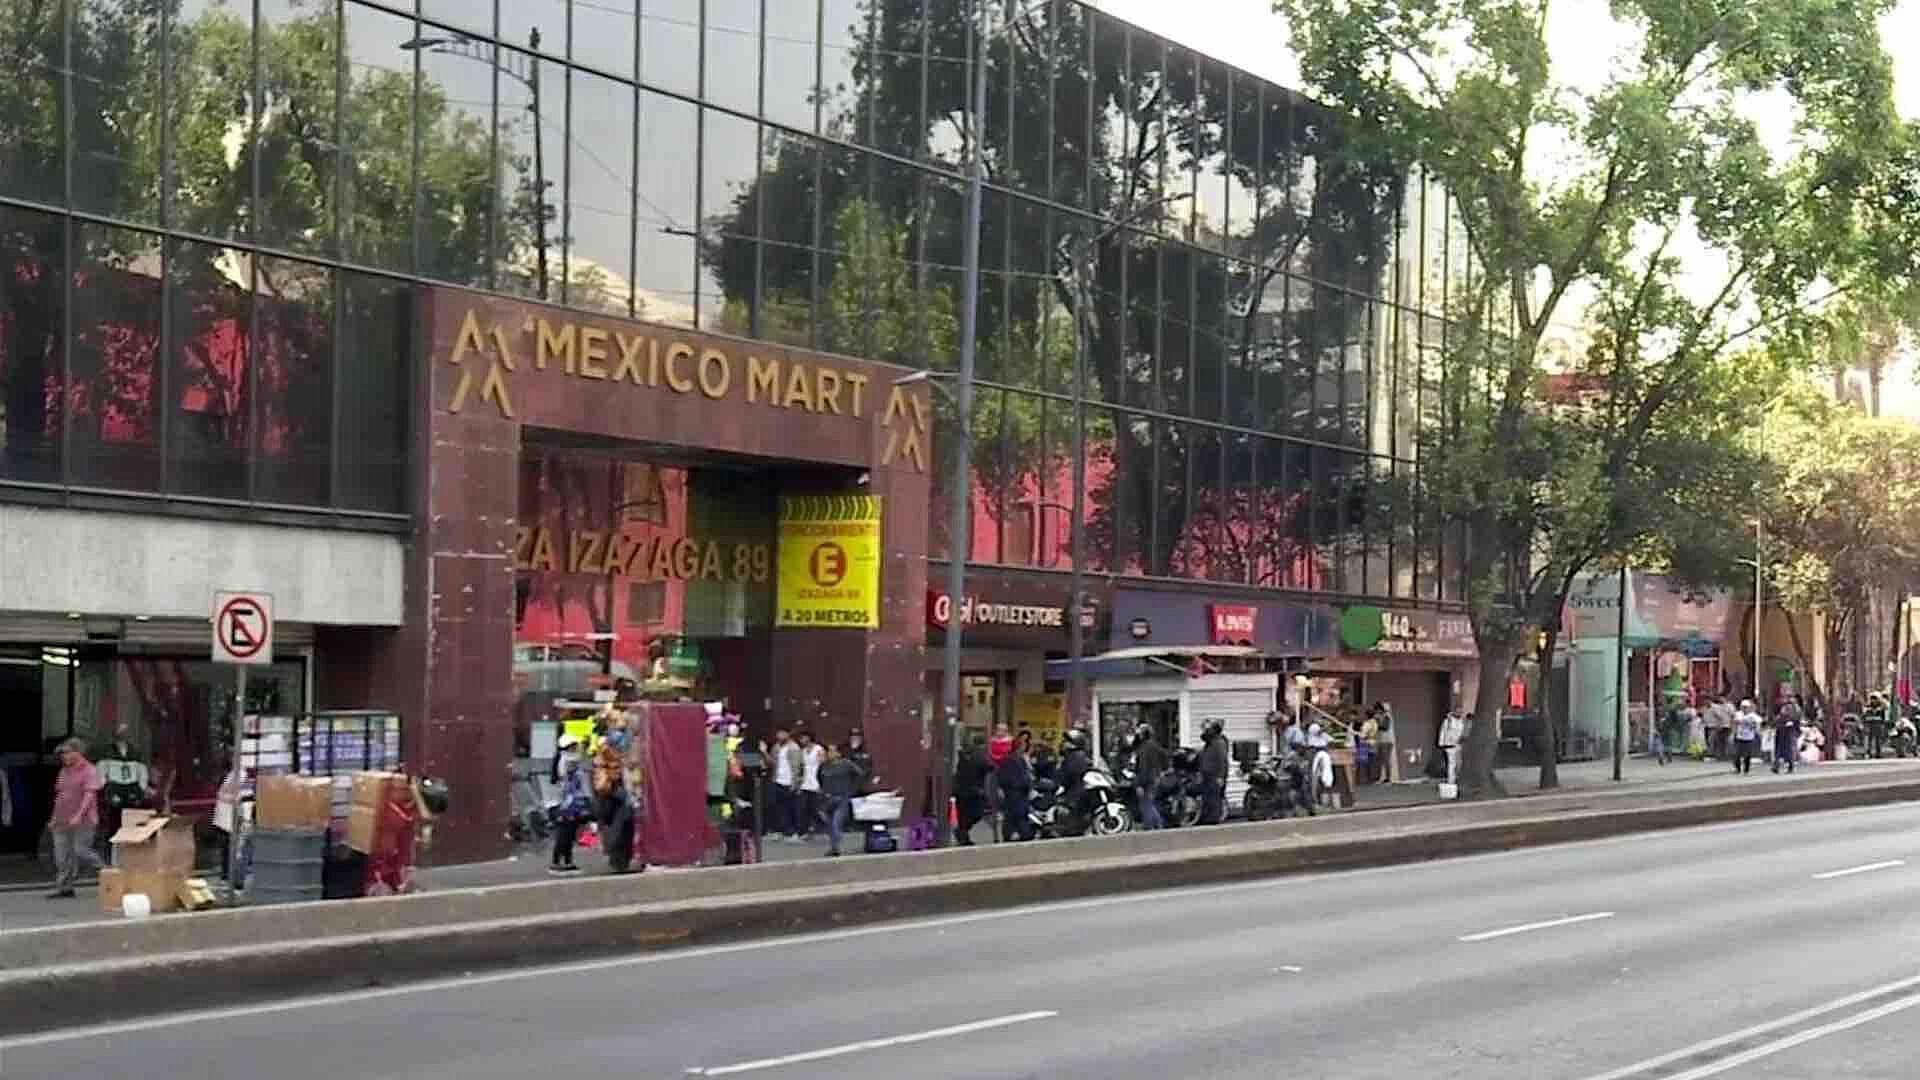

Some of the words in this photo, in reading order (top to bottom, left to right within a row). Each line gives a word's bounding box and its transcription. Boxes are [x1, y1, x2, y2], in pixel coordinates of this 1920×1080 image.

[536, 319, 730, 400] MEXICO
[747, 357, 868, 418] MART
[568, 529, 722, 581] IZAZAGA
[735, 543, 769, 583] 89
[817, 546, 839, 584] E
[815, 609, 870, 623] METROS
